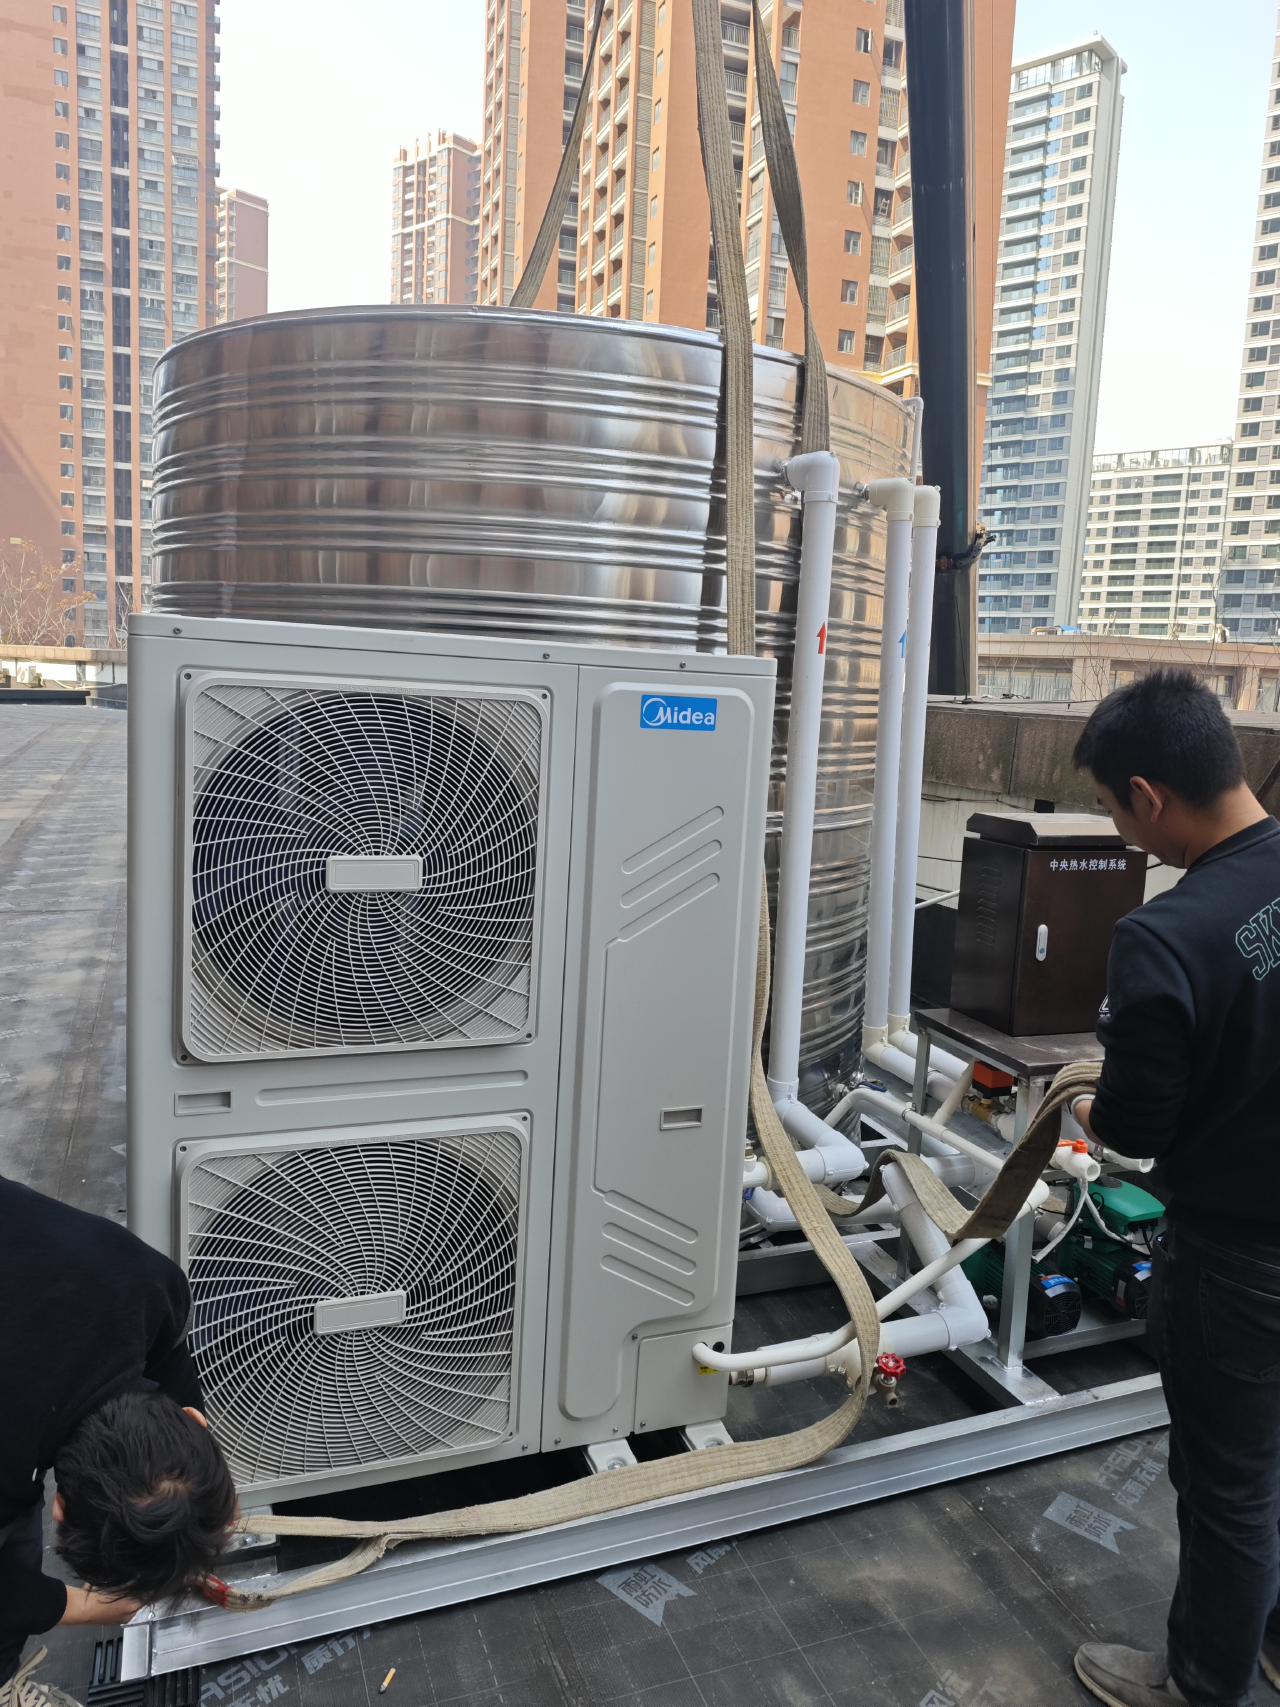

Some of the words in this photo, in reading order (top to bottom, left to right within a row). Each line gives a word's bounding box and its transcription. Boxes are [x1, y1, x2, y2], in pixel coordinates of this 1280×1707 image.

[643, 698, 714, 726] Midea
[1050, 858, 1126, 871] 中央热水控制系统
[1235, 897, 1280, 981] SK
